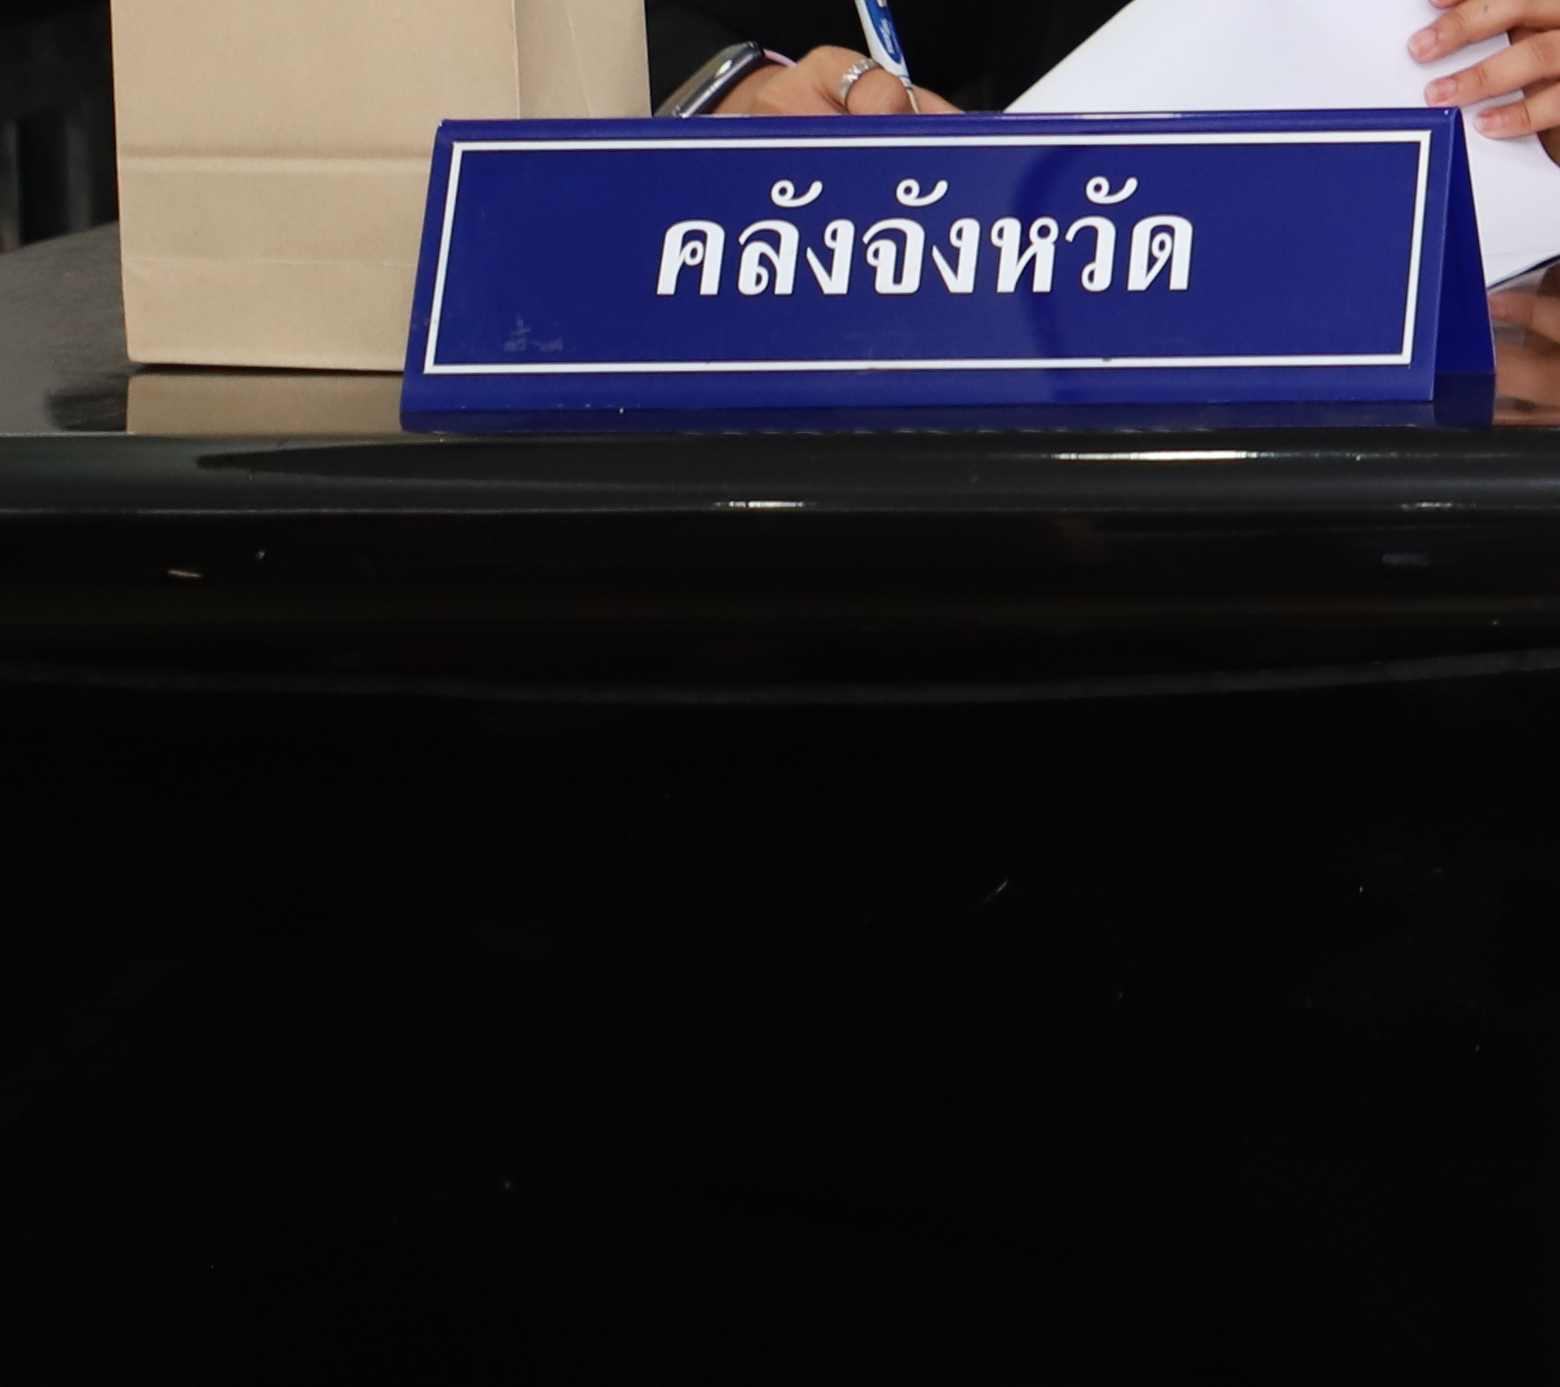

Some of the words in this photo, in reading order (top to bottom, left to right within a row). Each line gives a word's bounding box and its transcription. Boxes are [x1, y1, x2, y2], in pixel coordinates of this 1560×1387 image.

[656, 175, 1194, 296] คลังจังหวัด
